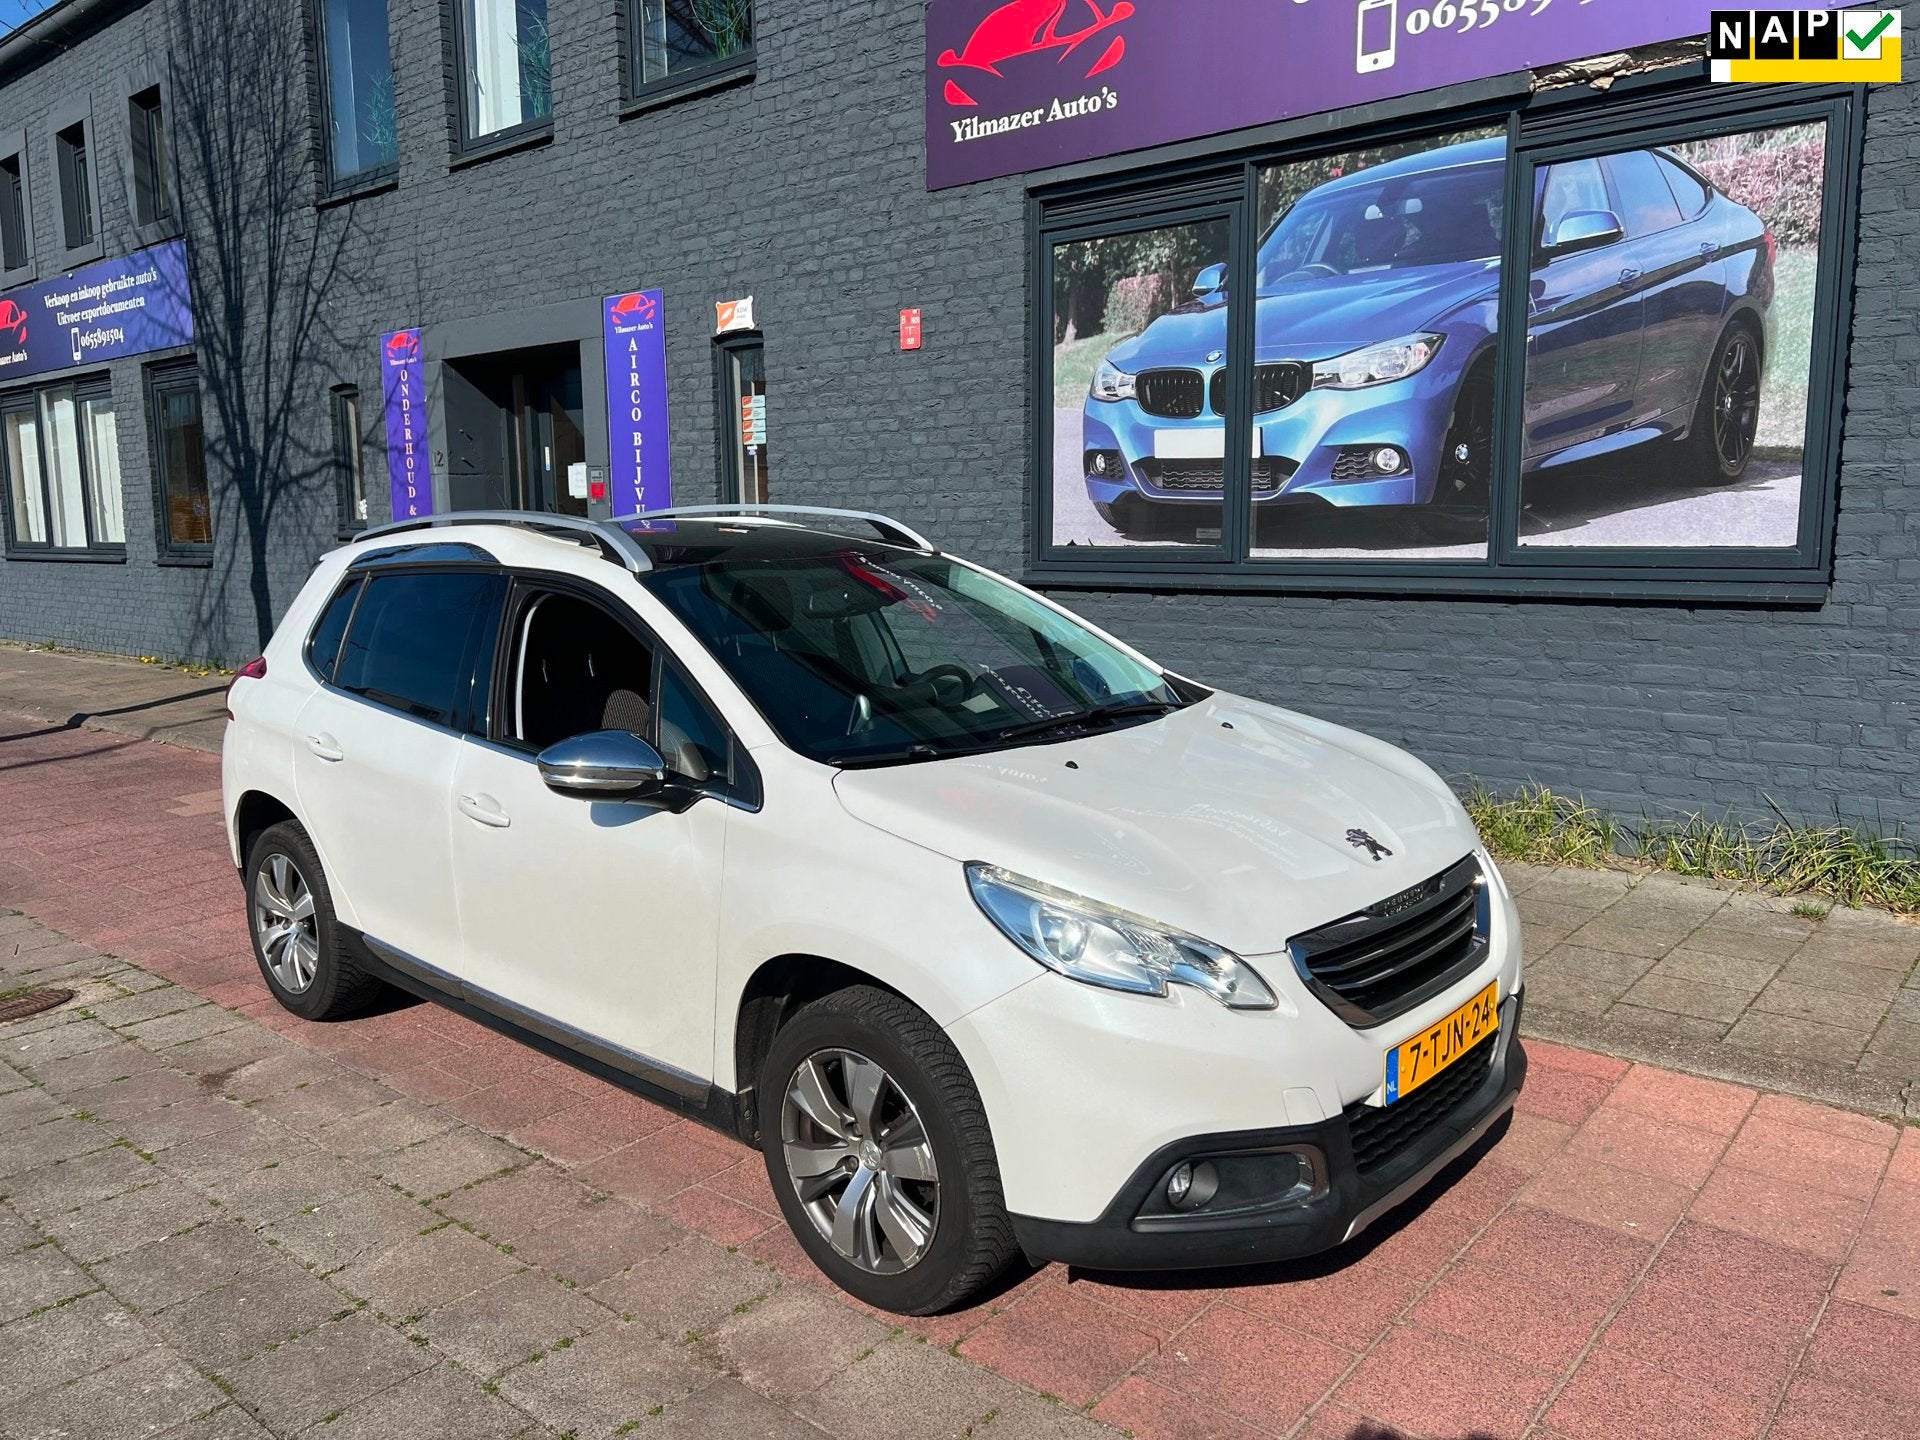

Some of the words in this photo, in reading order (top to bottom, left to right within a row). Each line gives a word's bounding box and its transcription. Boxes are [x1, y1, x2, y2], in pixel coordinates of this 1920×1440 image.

[951, 108, 1044, 142] Yilmazer
[1046, 87, 1117, 122] Auto's
[44, 293, 69, 309] Verkoop
[70, 291, 78, 302] en
[78, 285, 100, 301] inkoop
[101, 274, 135, 299] gebruikte
[135, 267, 157, 285] auto's
[57, 311, 80, 326] Uitvoer
[81, 296, 145, 323] exportdocumenten
[80, 327, 124, 350] 0655891504
[628, 337, 642, 422] AIRCO
[400, 369, 417, 499] ONDERHOUD
[409, 504, 417, 516] &
[632, 432, 646, 513] BIJVU
[1409, 993, 1490, 1084] 7-TJN-24
[1386, 1080, 1397, 1095] NL
